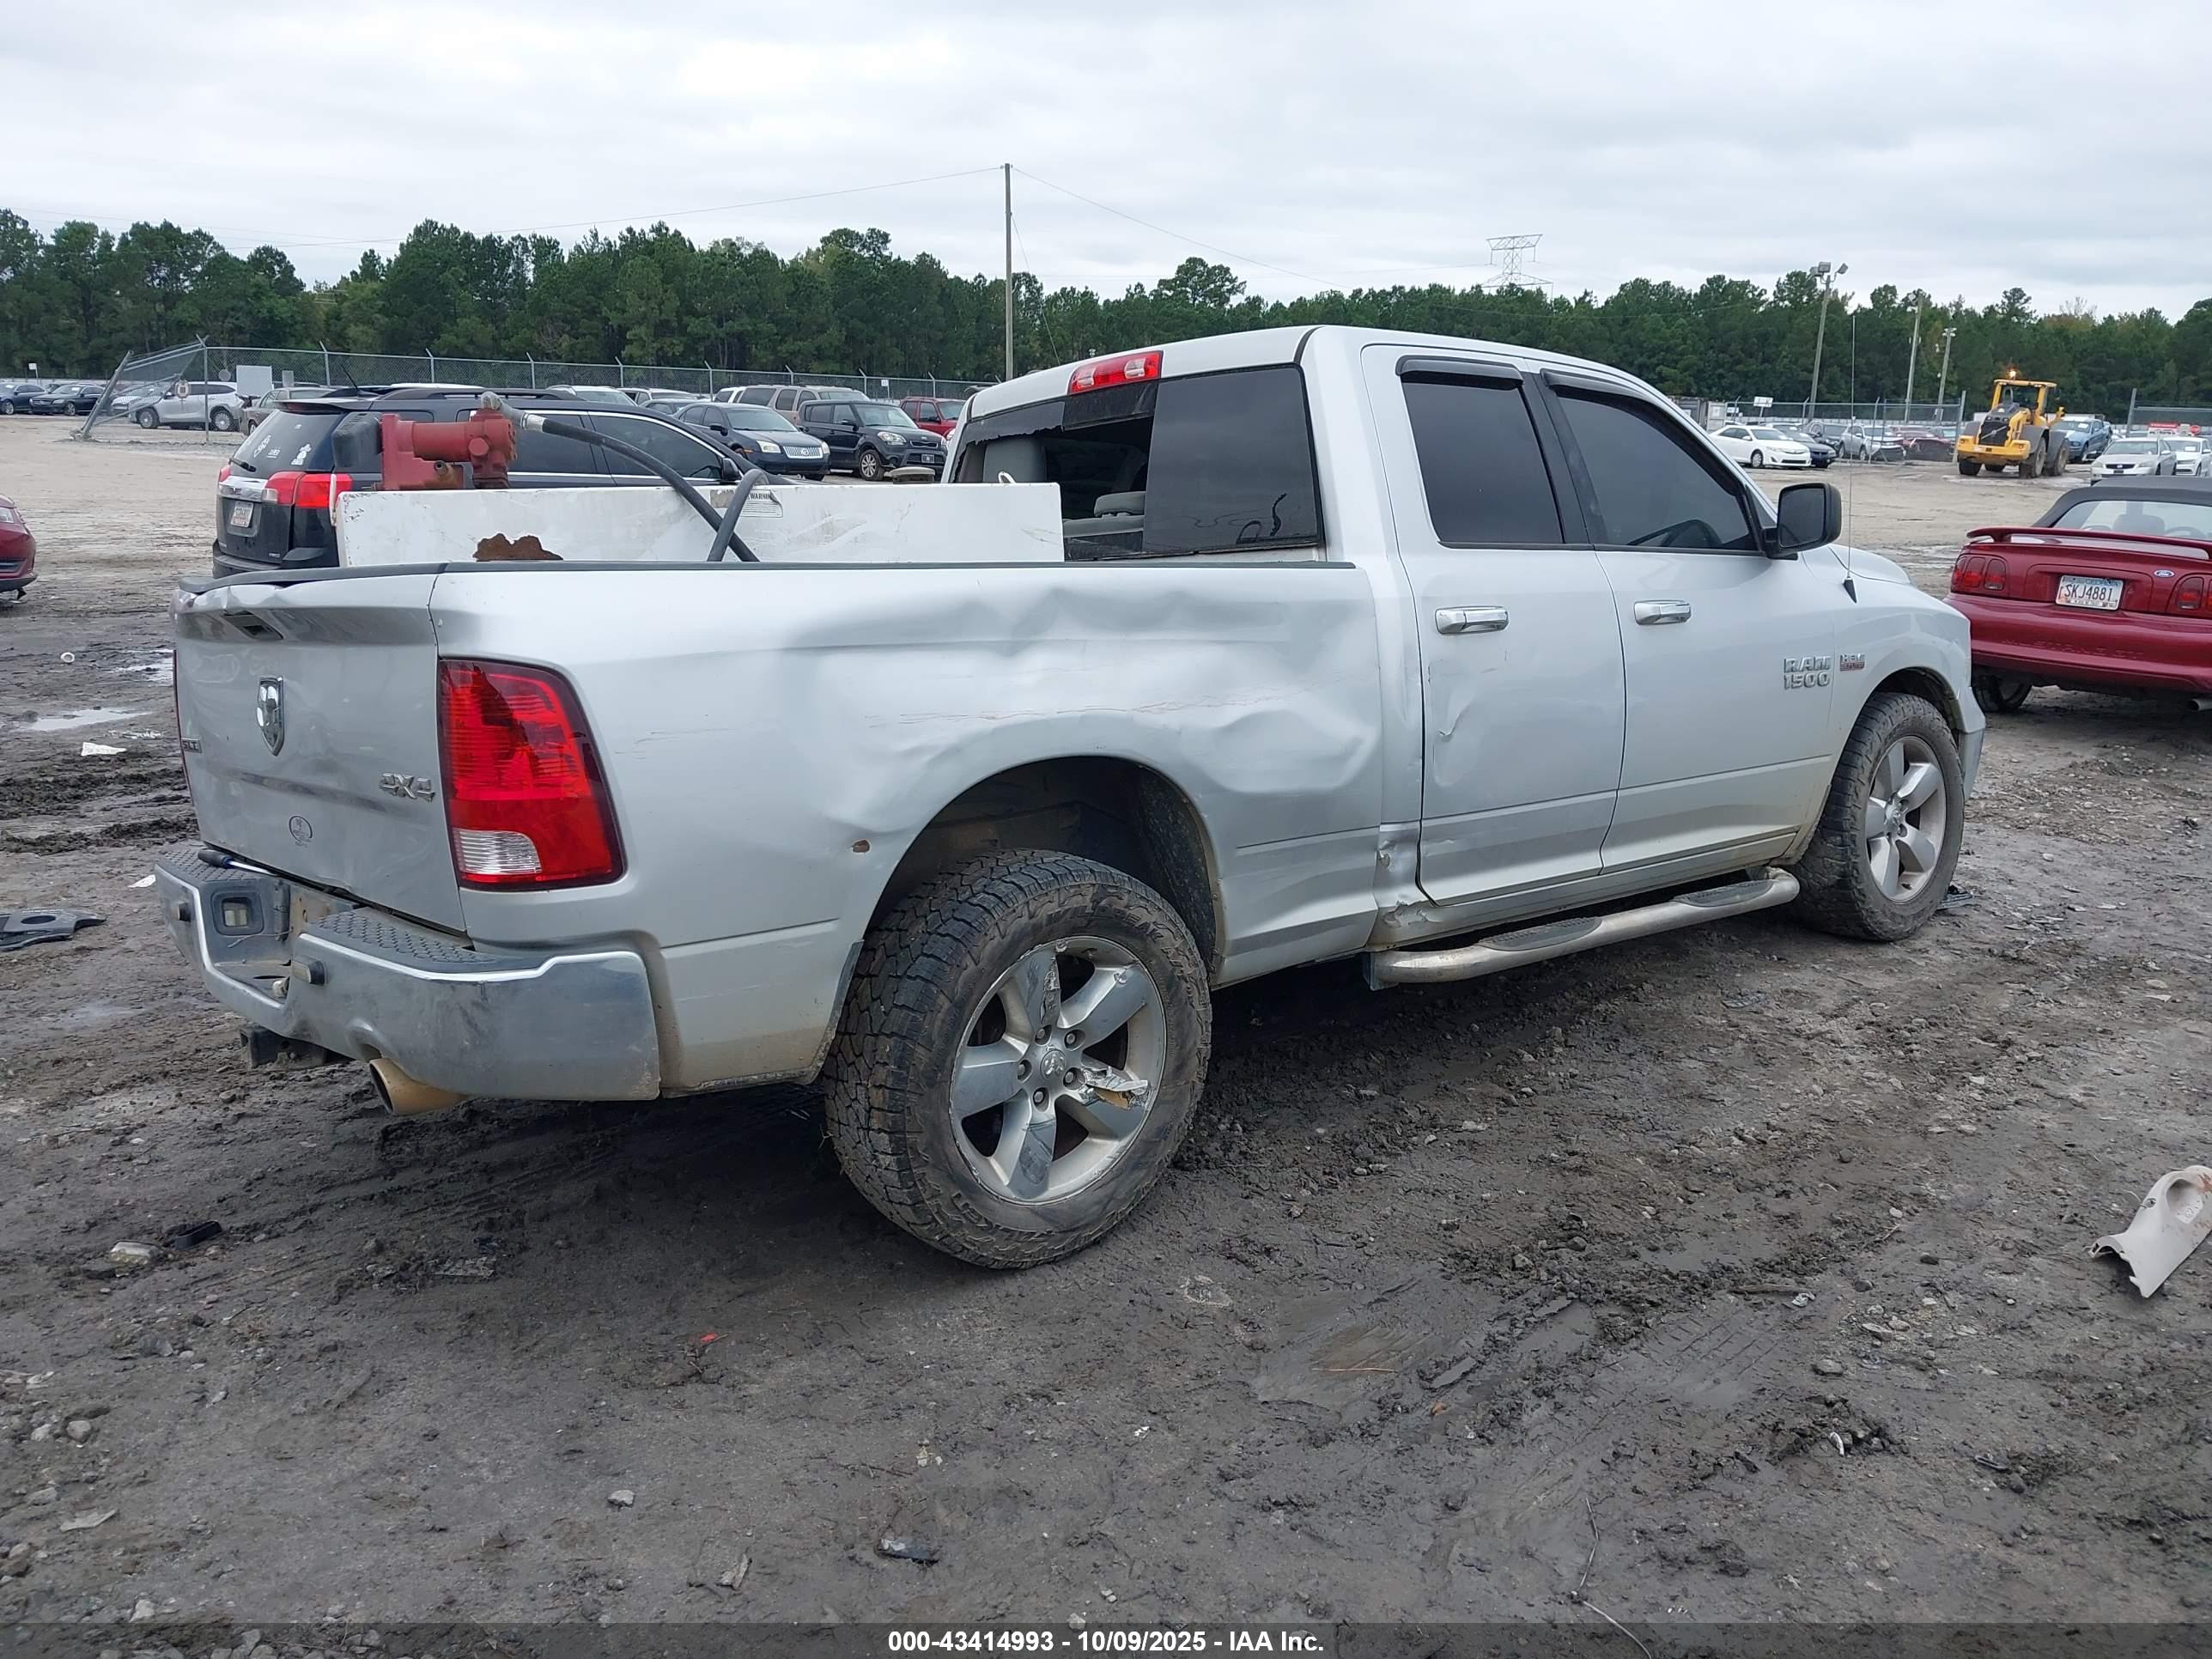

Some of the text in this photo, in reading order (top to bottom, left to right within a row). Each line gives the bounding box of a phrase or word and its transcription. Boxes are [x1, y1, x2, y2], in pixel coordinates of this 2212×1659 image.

[2064, 584, 2113, 601] SKJ4881
[1784, 655, 1832, 673] RAM
[1784, 672, 1830, 690] 1500
